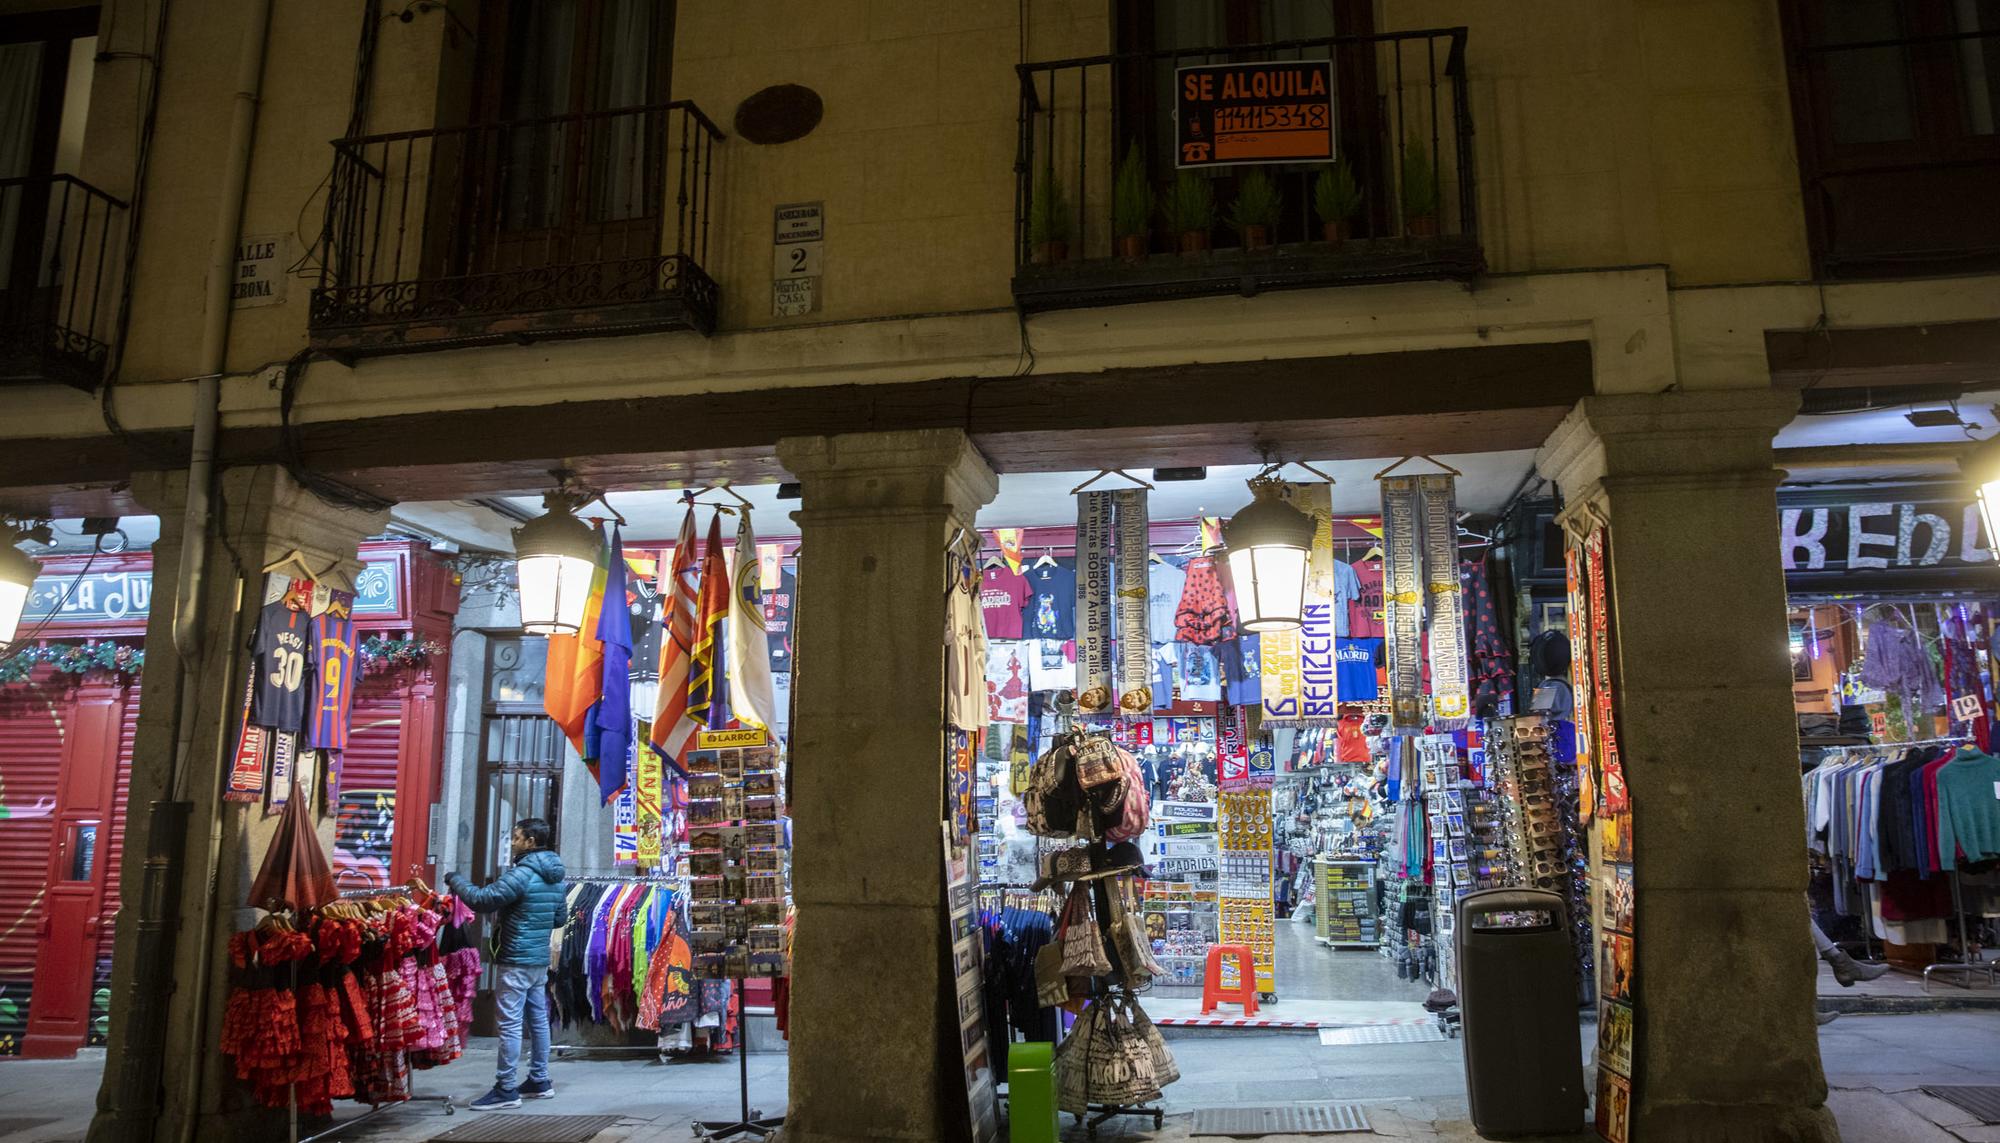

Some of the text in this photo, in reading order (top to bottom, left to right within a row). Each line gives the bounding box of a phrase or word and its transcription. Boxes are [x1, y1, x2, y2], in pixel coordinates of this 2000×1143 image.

[1185, 69, 1326, 101] SE ALQUILA
[237, 243, 275, 261] ALLE
[790, 248, 807, 273] 2
[242, 265, 256, 278] DE
[232, 280, 273, 299] ERONA
[1089, 515, 1101, 548] mirás
[1100, 491, 1109, 549] ARGENTINA
[1428, 501, 1449, 556] MUNDO!
[1088, 552, 1099, 597] BOBO?
[1431, 557, 1450, 580] DEL
[60, 572, 152, 619] LA JU
[1078, 583, 1086, 600] 1986
[1088, 601, 1100, 632] Andá
[1101, 611, 1109, 630] DEL
[1126, 602, 1145, 625] DEL
[1396, 606, 1416, 629] DEL
[1078, 645, 1087, 663] 2022
[1101, 635, 1109, 673] MUNDO
[1126, 628, 1146, 682] MUNDO!
[1263, 634, 1280, 676] 2022
[1336, 650, 1369, 662] MADRID
[1396, 631, 1417, 687] MUNDO!
[270, 646, 304, 693] 30
[325, 657, 341, 698] 9
[1281, 673, 1297, 696] Oro
[1955, 698, 1980, 717] 12
[718, 732, 758, 742] LARROC
[1226, 705, 1238, 755] RIVER
[615, 834, 637, 851] 14
[1166, 858, 1210, 873] MADRID
